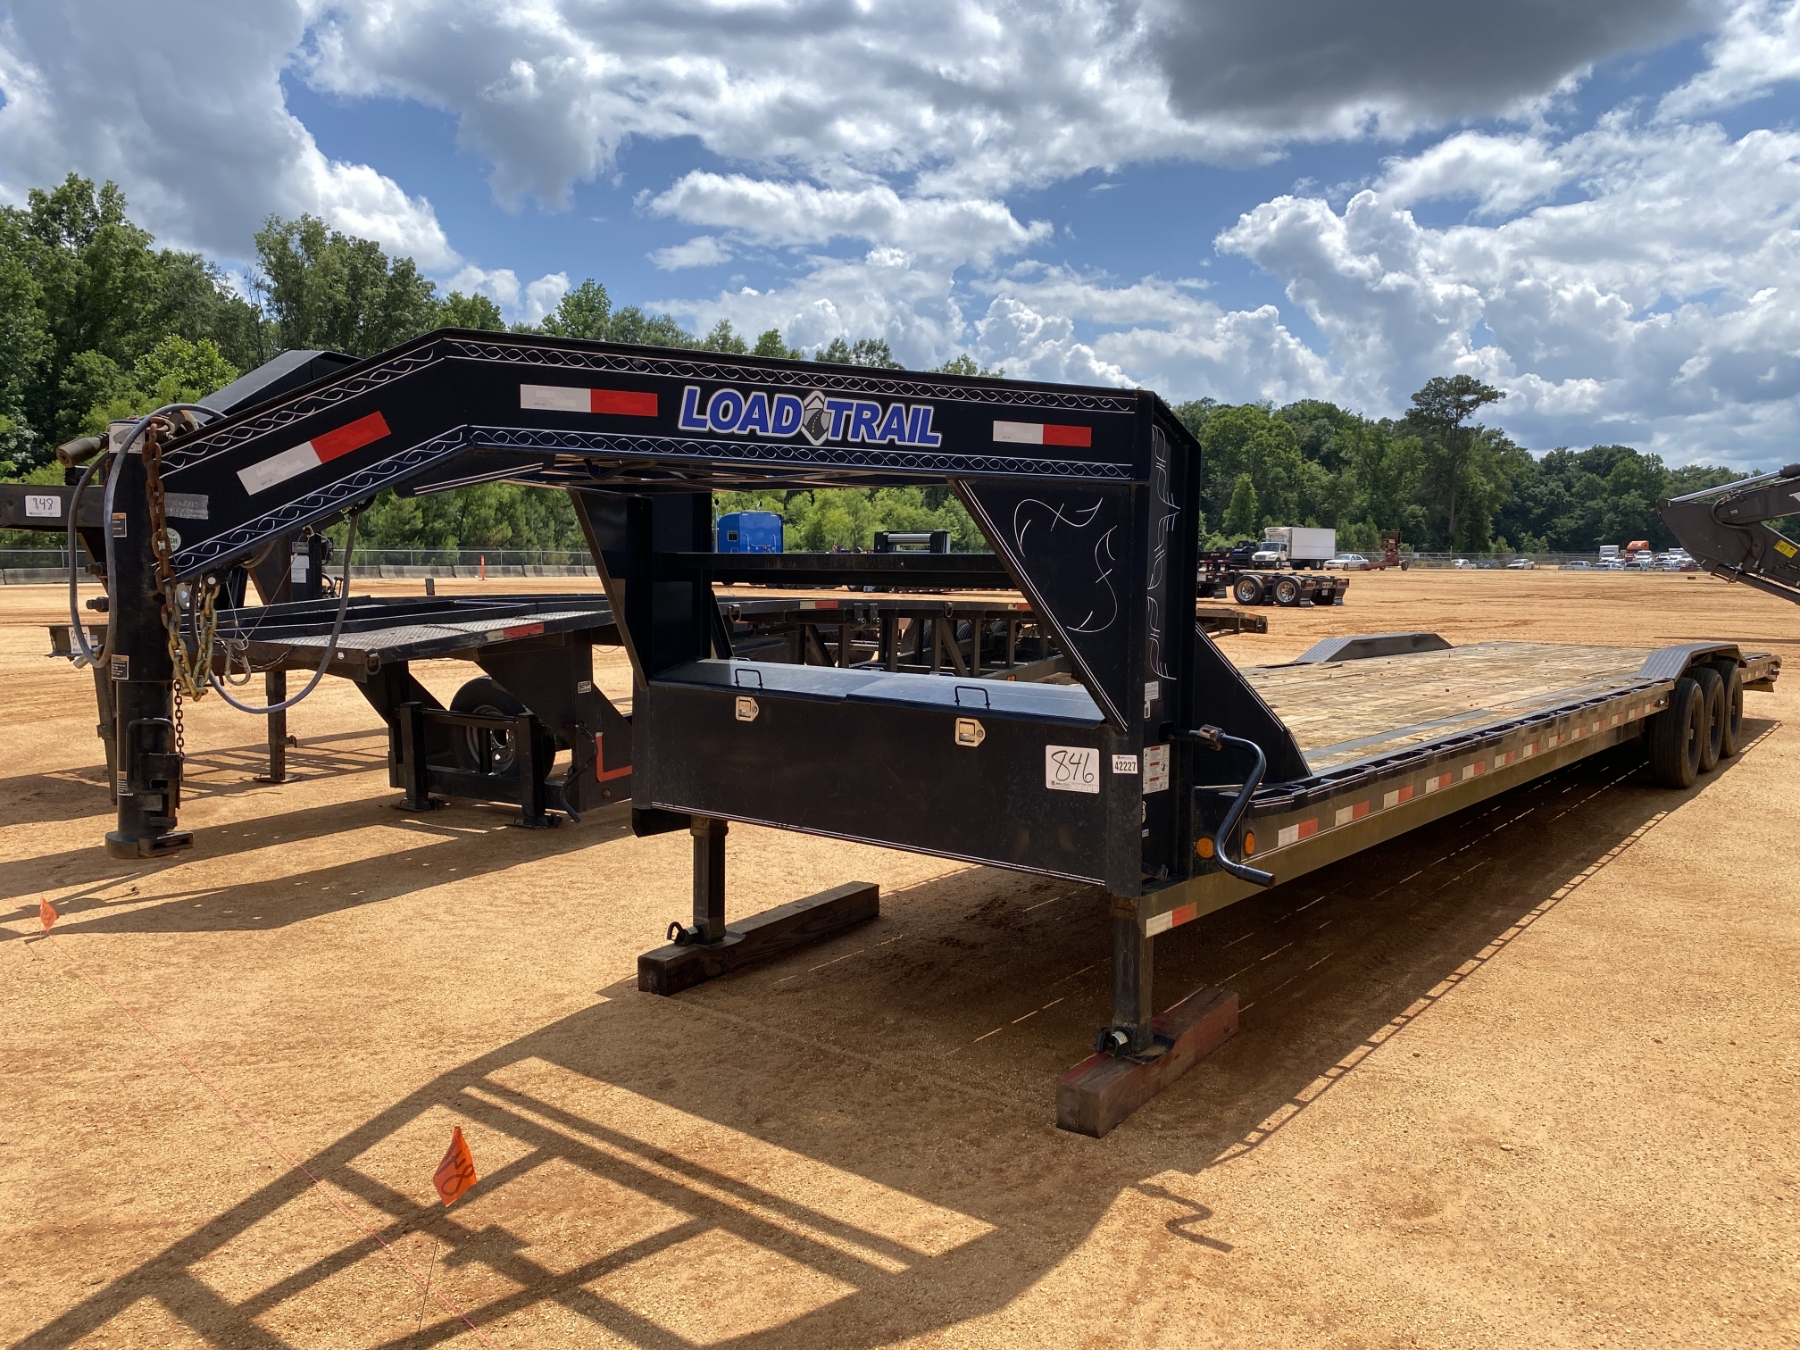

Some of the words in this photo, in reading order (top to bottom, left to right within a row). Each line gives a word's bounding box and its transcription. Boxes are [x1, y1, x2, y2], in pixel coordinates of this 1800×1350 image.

[678, 386, 804, 438] LOAD
[823, 398, 942, 447] TRAIL
[1051, 750, 1094, 783] 846
[1114, 761, 1136, 771] 42227
